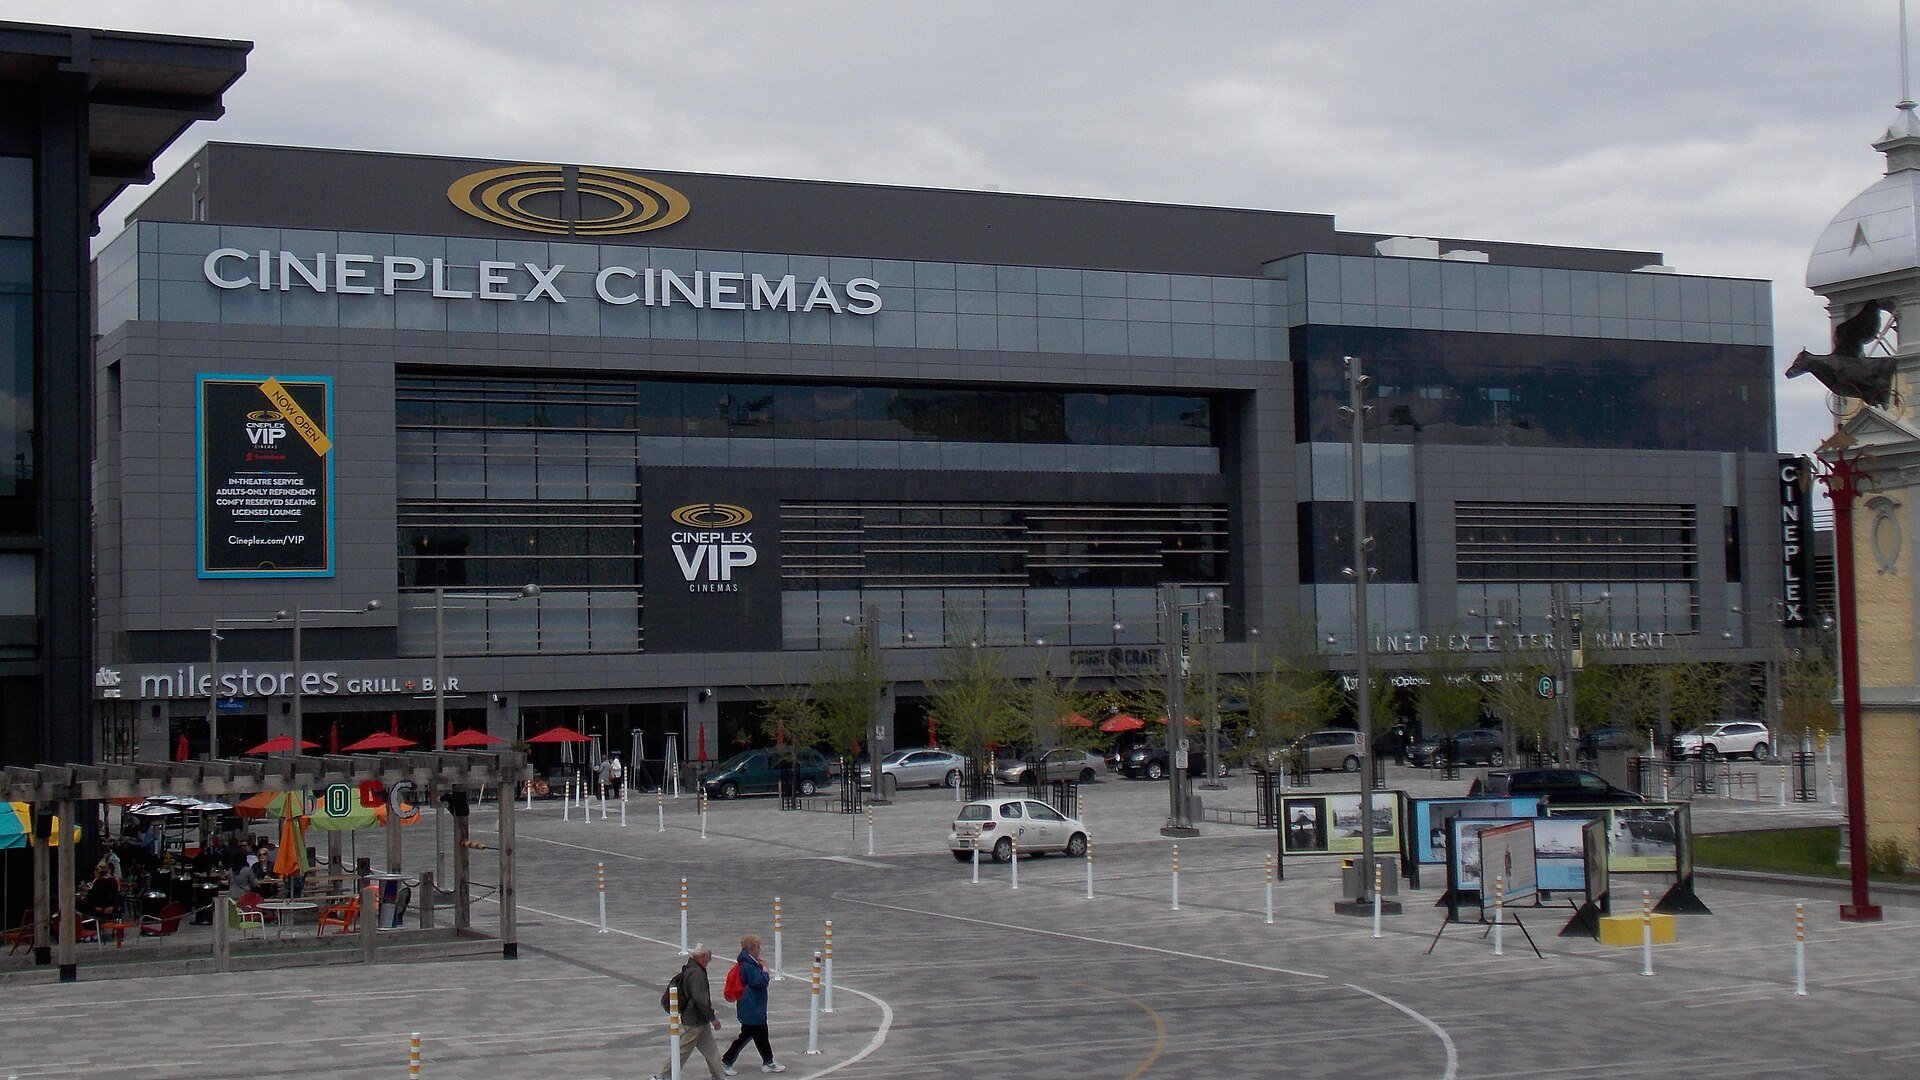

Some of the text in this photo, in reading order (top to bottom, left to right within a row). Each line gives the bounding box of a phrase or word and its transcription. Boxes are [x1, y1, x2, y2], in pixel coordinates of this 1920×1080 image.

[203, 248, 883, 316] CINEPLEX CINEMAS
[272, 390, 320, 443] NOW OPEN
[245, 428, 287, 445] VIP
[228, 478, 304, 486] IN-THEATRE SERVICE
[215, 488, 316, 496] ADULTS-ONLY REFINEMENT
[215, 498, 317, 506] COMFY RESERVED SEATING
[228, 535, 305, 546] Cineplex.com/VIP
[671, 532, 753, 543] CINEPLEX
[1781, 465, 1803, 621] CINEPLEX
[671, 544, 757, 581] VIP
[689, 583, 738, 592] CINEMAS
[1376, 634, 1471, 652] INEPEX
[346, 678, 402, 693] GRILL
